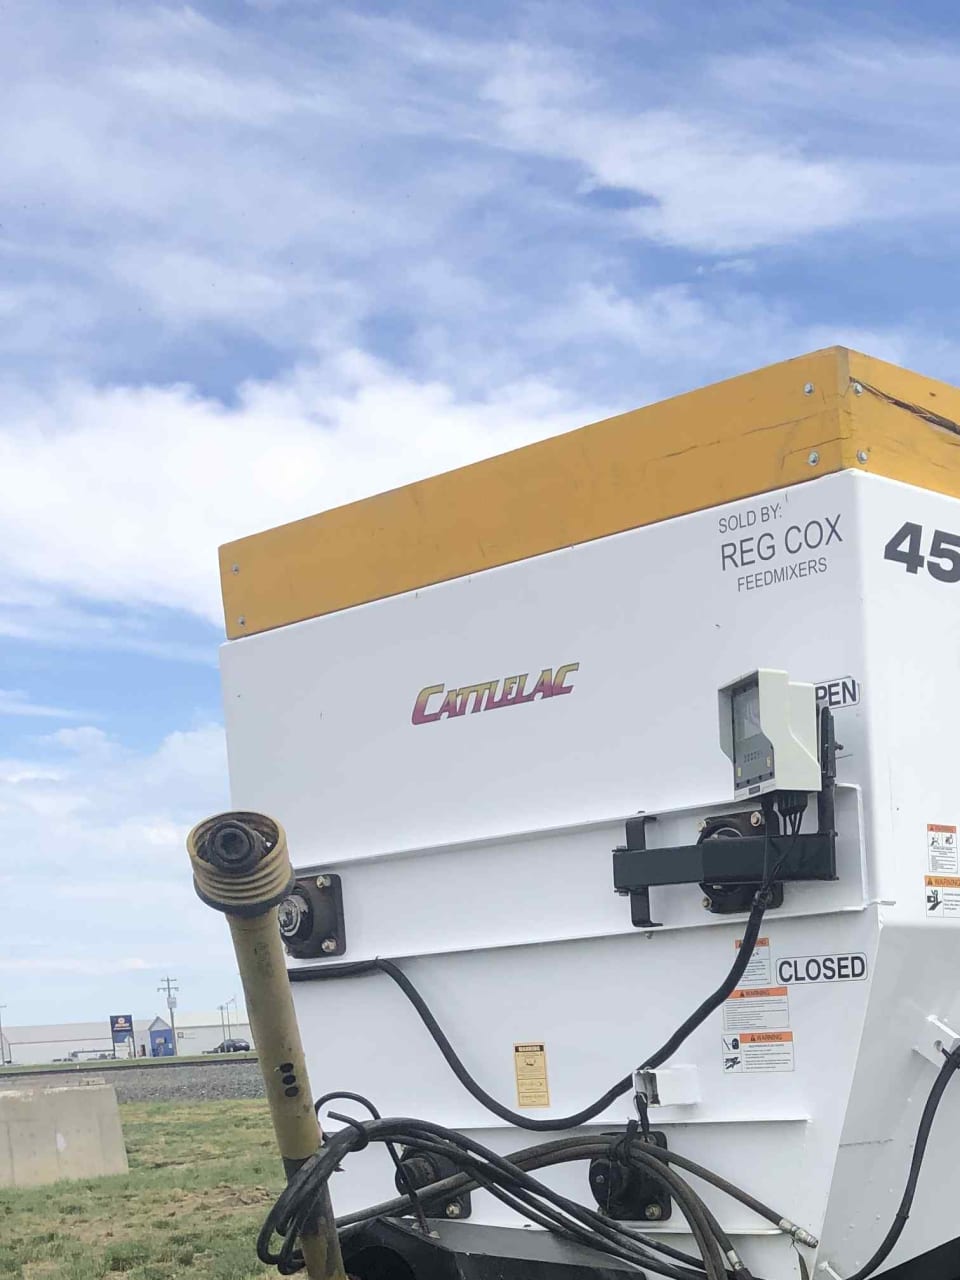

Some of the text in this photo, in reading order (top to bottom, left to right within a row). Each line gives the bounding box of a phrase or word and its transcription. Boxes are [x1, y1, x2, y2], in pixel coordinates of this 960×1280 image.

[718, 502, 783, 534] SOLD BY:
[720, 514, 843, 571] REG COX
[737, 557, 828, 592] FEEDMIXERS
[815, 679, 856, 706] PEN
[778, 956, 866, 983] CLOSED
